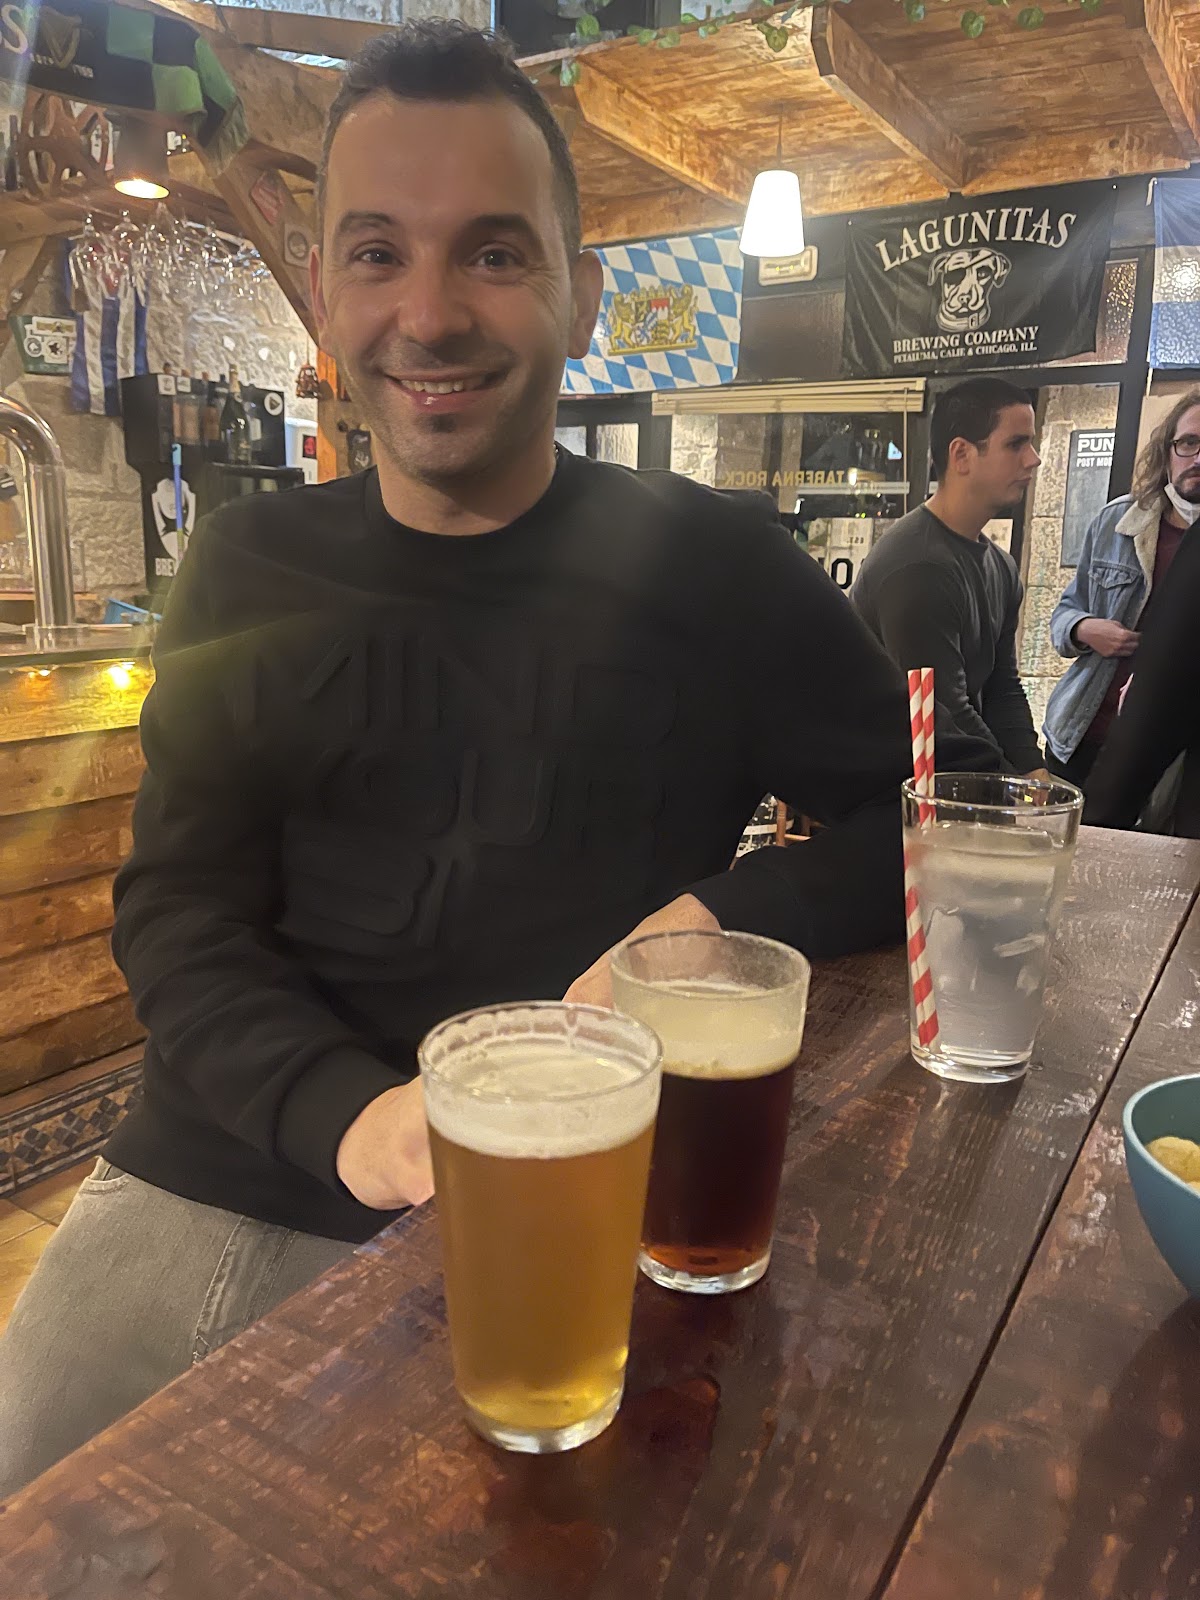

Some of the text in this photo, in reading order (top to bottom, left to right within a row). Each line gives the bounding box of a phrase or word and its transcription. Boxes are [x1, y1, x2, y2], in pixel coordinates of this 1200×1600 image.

[0, 4, 29, 54] S
[876, 207, 1076, 271] LAGUNITAS
[893, 325, 1039, 353] BREWING COMPANY
[1076, 457, 1095, 467] POST
[155, 557, 177, 576] BRE
